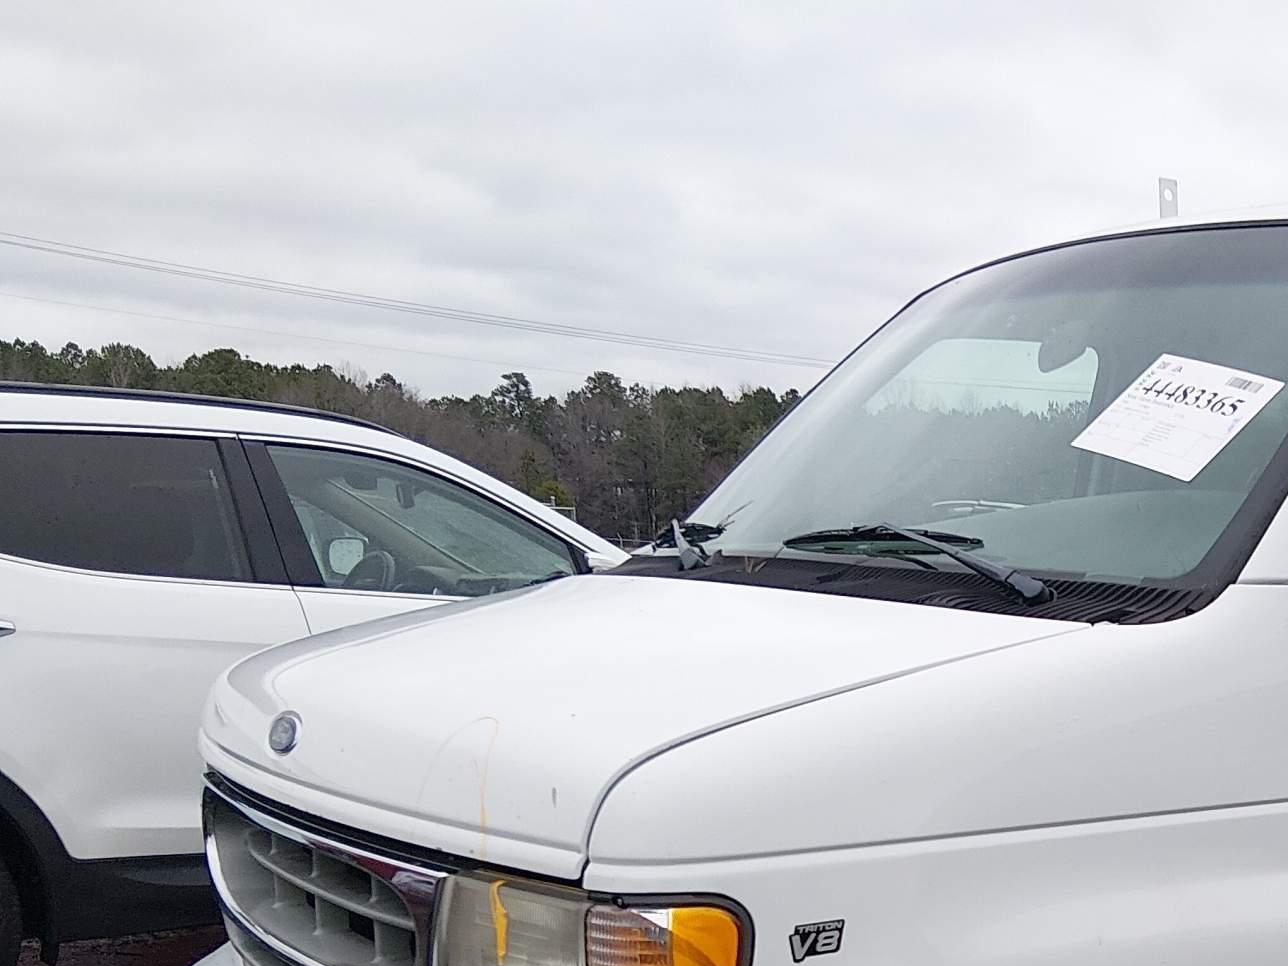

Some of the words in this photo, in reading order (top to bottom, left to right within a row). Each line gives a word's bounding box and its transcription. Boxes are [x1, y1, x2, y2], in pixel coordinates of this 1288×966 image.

[1142, 378, 1246, 417] 44483365
[797, 921, 842, 934] TRITON
[791, 930, 840, 960] V8
